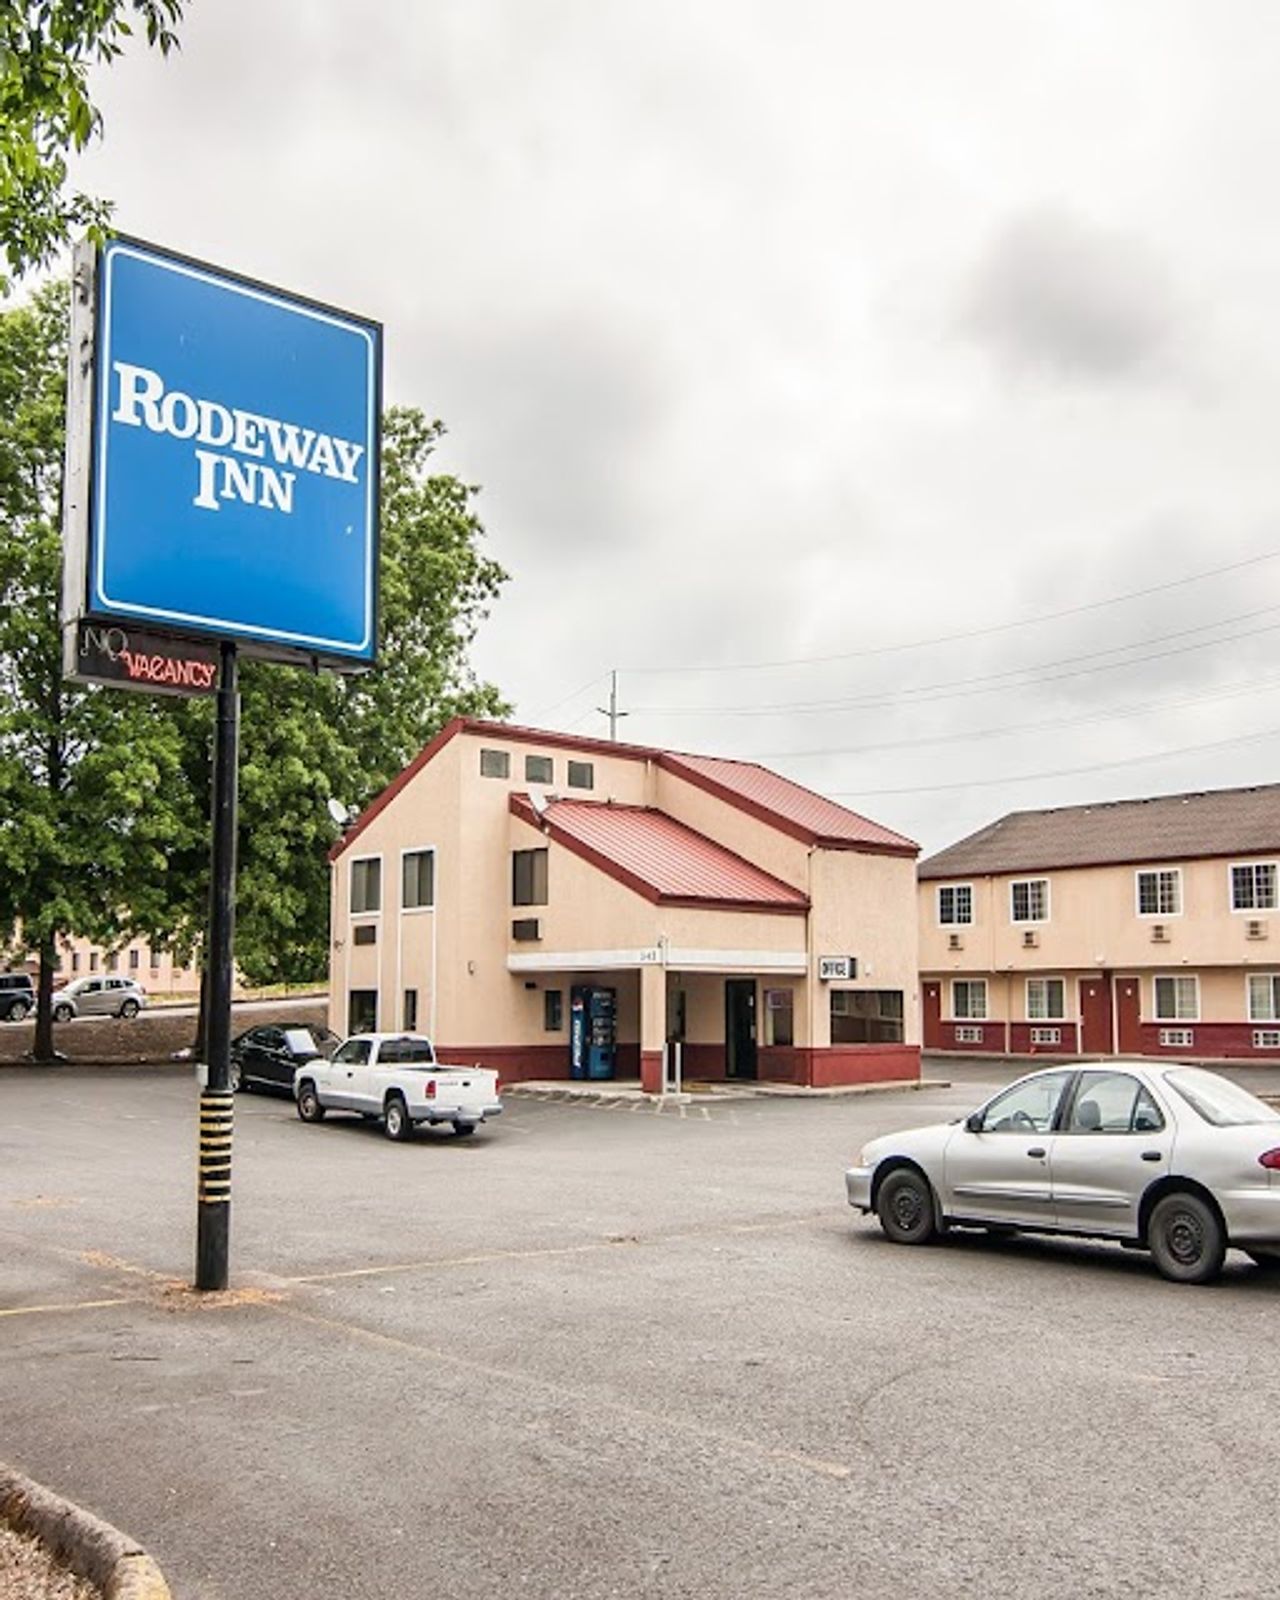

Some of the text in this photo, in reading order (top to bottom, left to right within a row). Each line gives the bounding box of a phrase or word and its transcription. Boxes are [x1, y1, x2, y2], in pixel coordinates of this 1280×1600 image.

[113, 360, 364, 484] RODEWAY
[193, 449, 296, 514] INN
[80, 627, 216, 687] NO VACANCY
